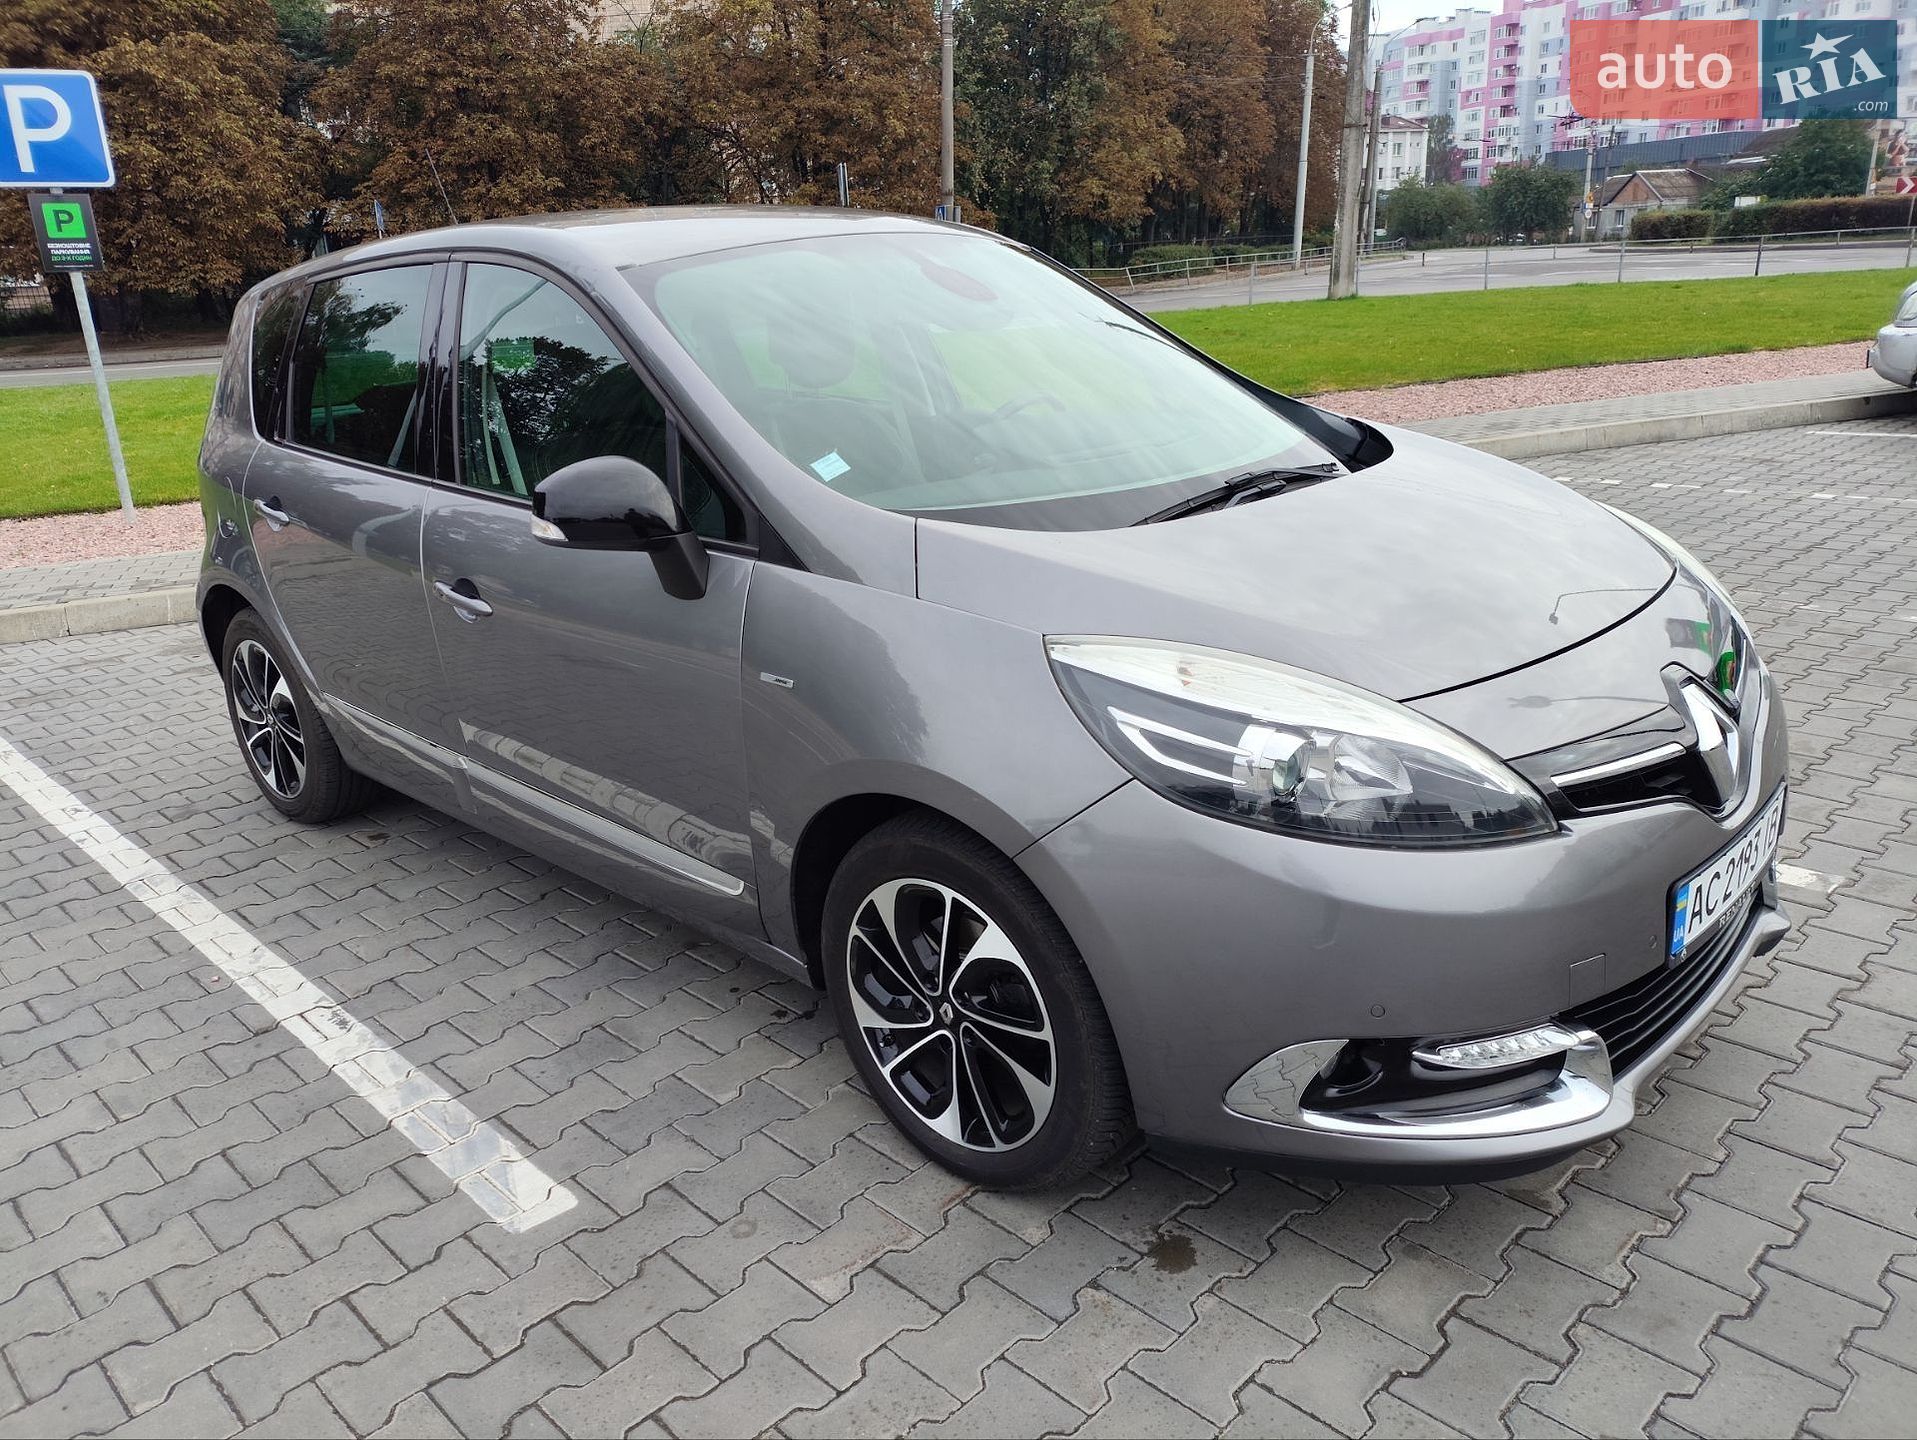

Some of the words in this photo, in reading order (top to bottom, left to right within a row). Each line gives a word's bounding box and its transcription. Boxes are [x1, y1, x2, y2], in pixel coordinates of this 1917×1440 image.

[3, 85, 71, 172] P
[52, 209, 74, 232] P
[1688, 871, 1721, 934] AC
[1723, 827, 1761, 903] 2193
[1763, 806, 1778, 857] IB
[1673, 924, 1684, 942] UA
